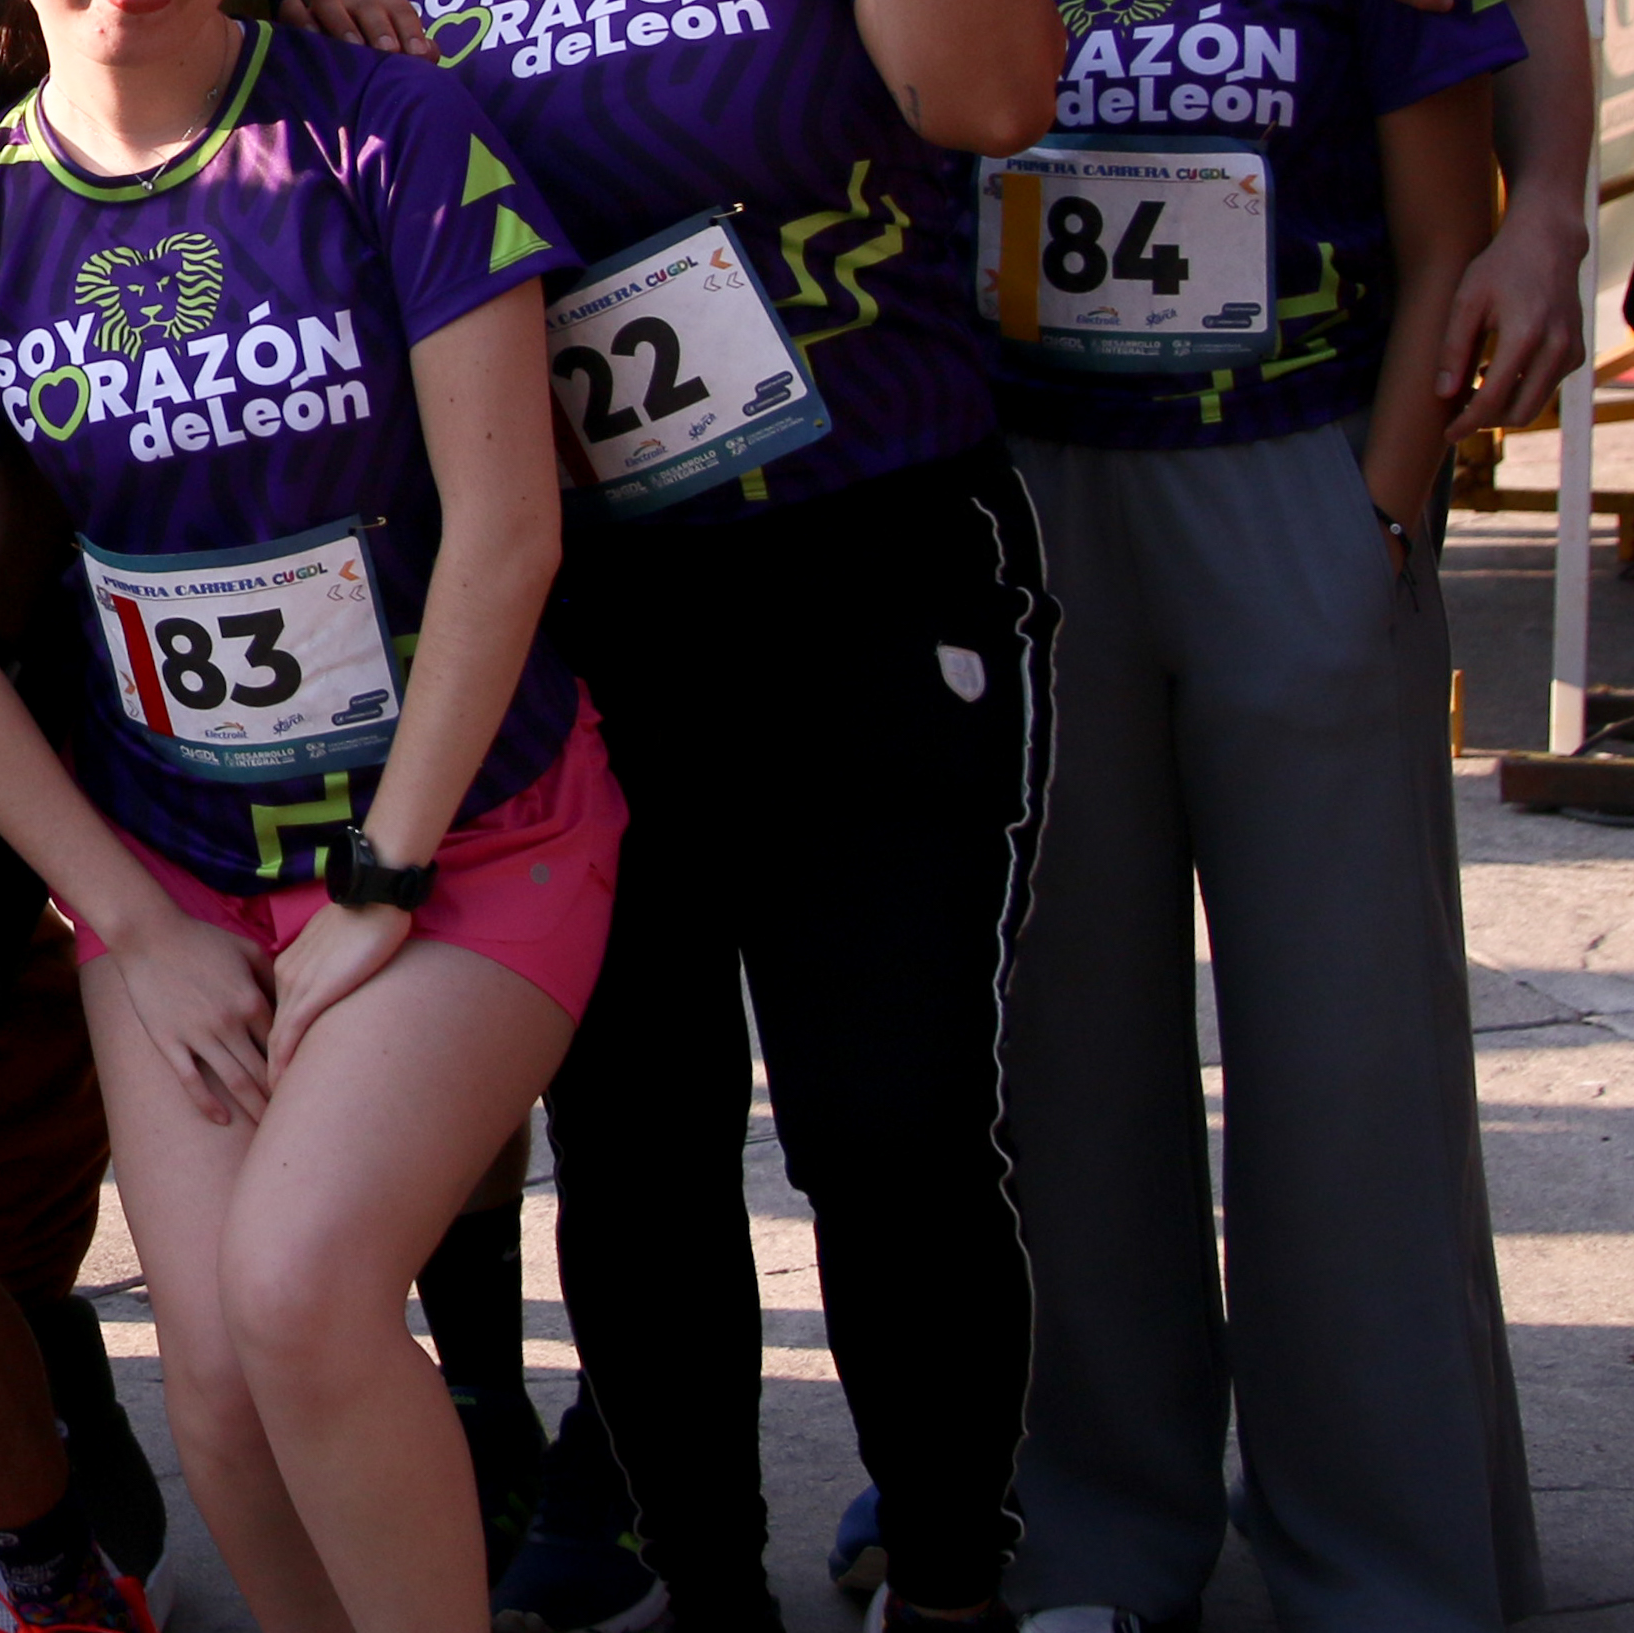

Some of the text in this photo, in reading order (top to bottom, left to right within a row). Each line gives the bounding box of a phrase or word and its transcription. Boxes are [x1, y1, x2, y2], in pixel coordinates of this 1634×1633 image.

[1056, 66, 1294, 128] deLeón
[1006, 159, 1231, 181] PRIMERA CARRERA CUGDL
[644, 255, 699, 289] CUGDL
[1042, 196, 1189, 295] 84
[552, 316, 711, 445] 22
[128, 370, 371, 463] deLeón
[102, 562, 329, 598] PRIMERA CARRERA CUGDL
[153, 607, 302, 711] 83
[234, 747, 295, 761] DESARROLLO
